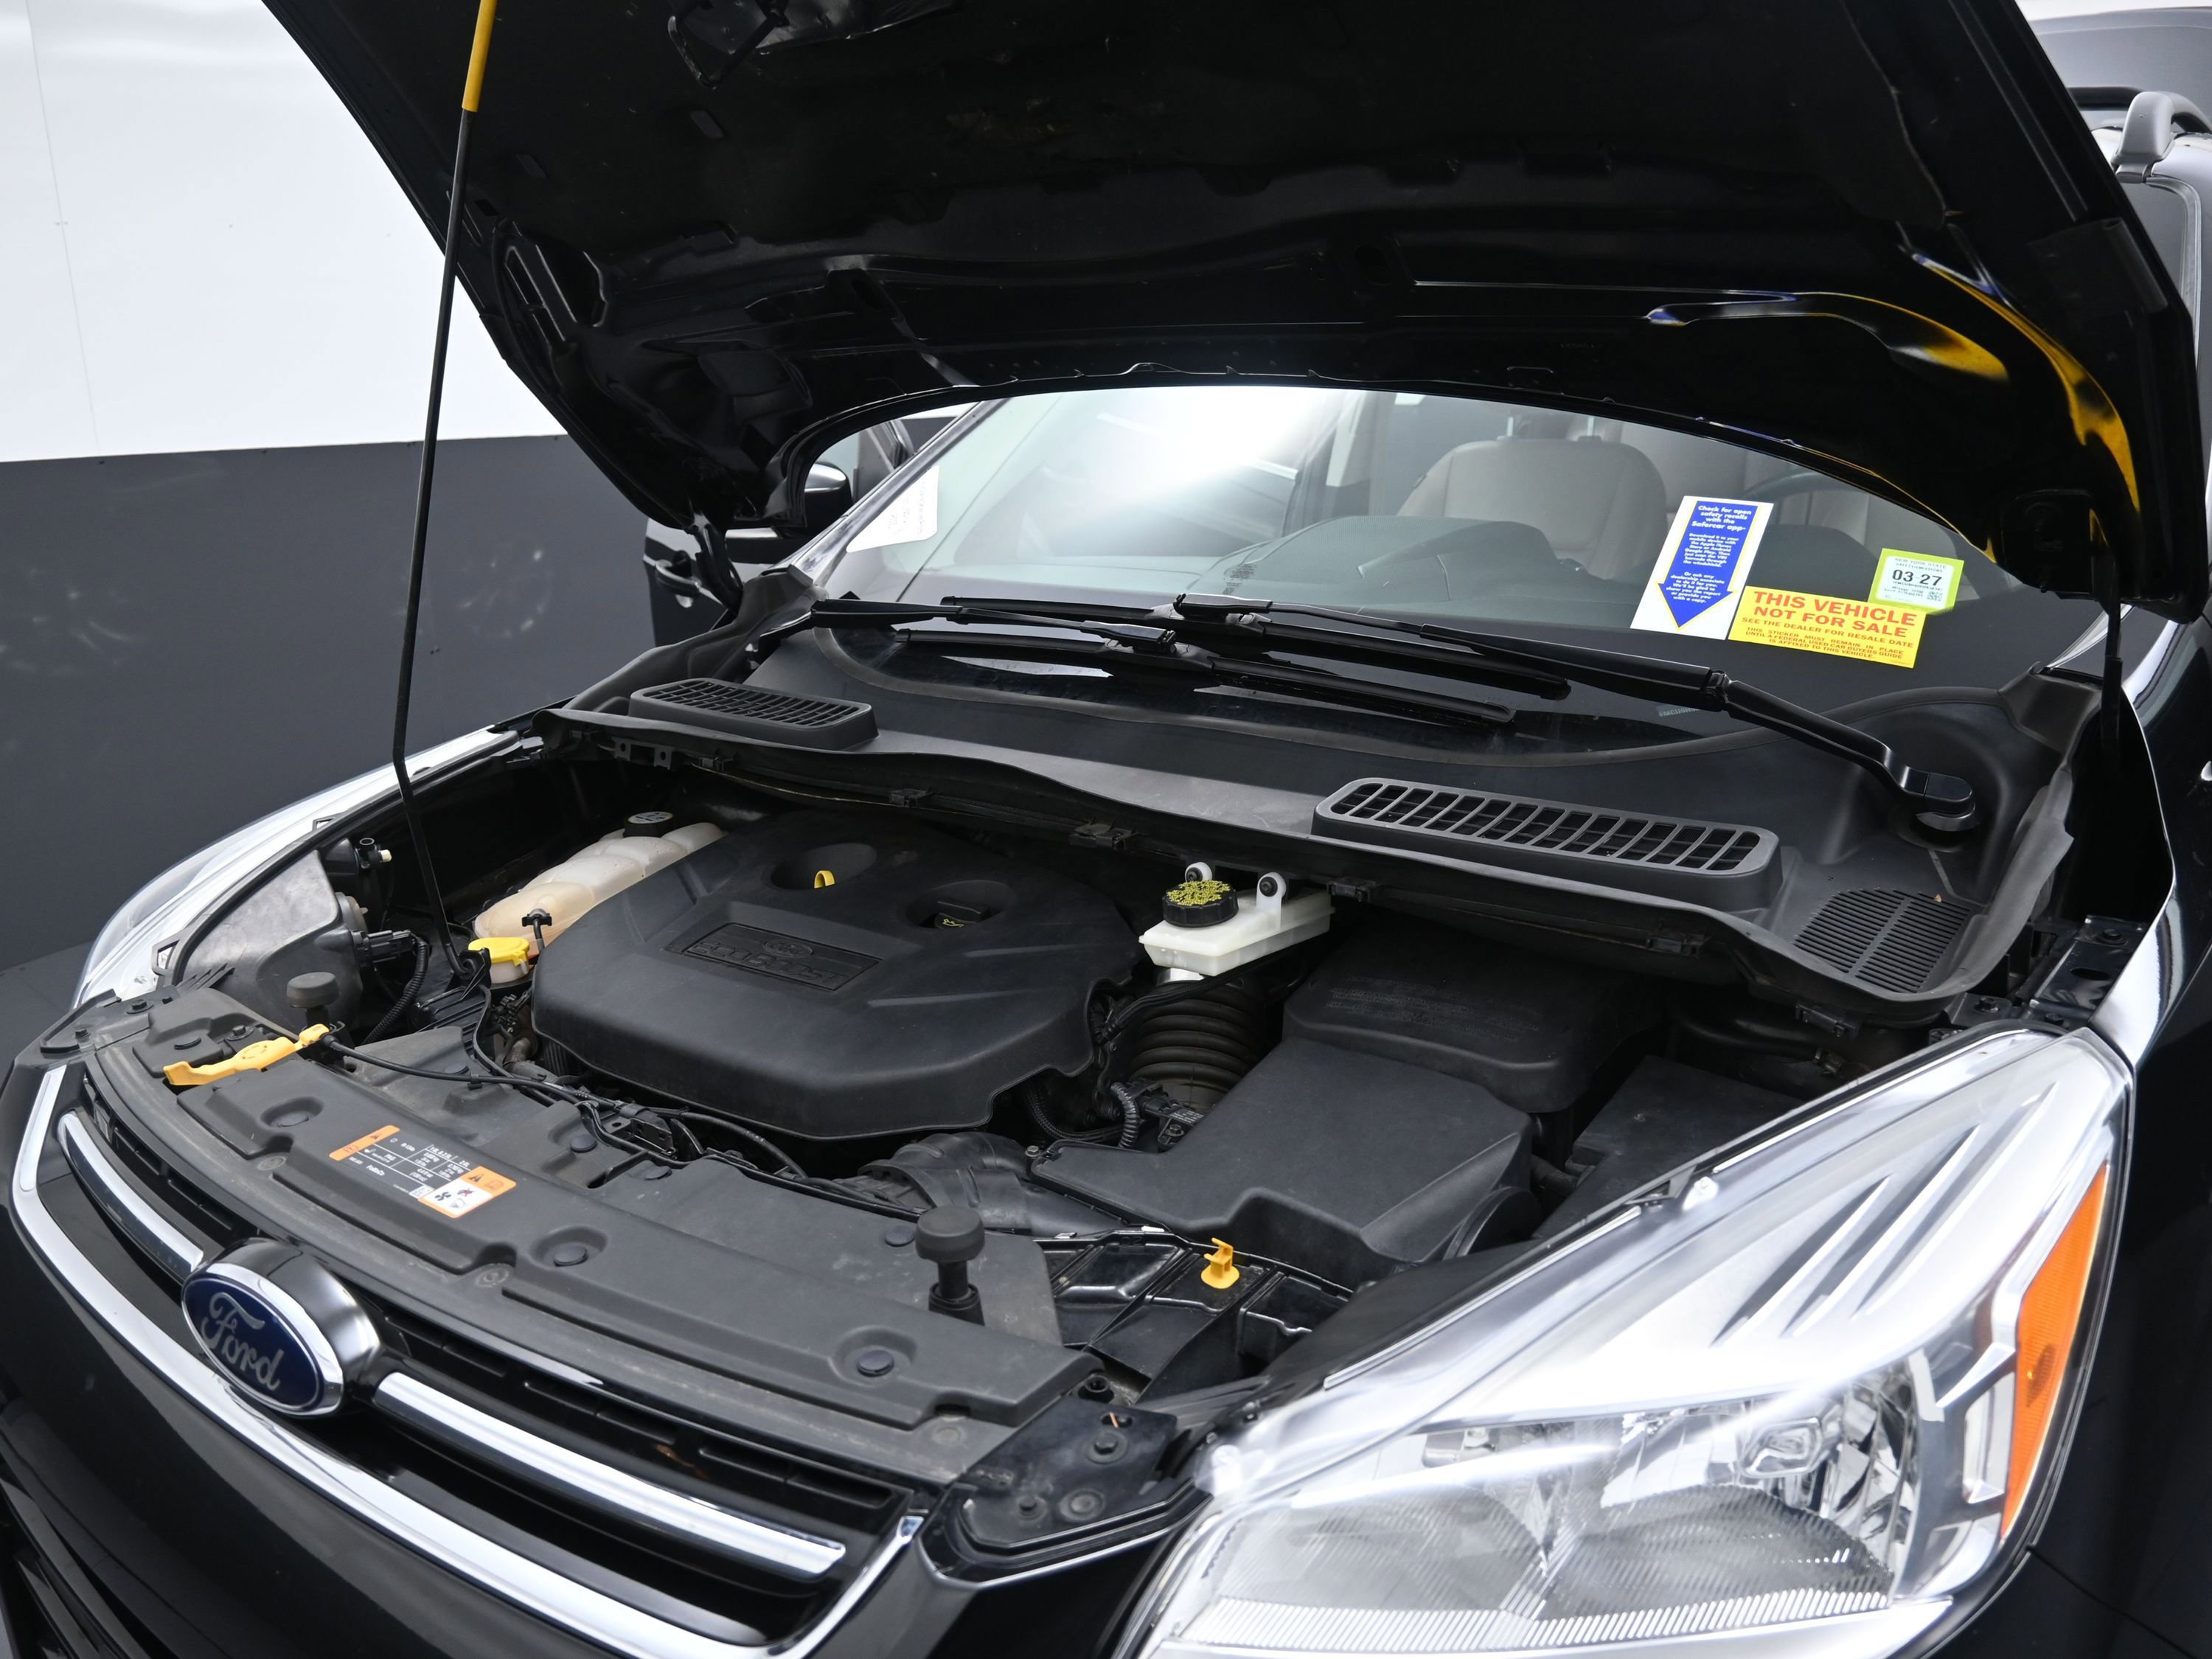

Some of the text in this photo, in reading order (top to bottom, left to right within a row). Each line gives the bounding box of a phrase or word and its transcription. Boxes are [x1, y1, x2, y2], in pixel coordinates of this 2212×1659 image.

[1892, 569, 1914, 582] 03
[1919, 574, 1942, 586] 27
[1754, 591, 1917, 626] THIS VEHICLE
[1754, 606, 1908, 637] NOT FOR SALE
[1768, 630, 1799, 638] STICKER
[1830, 639, 1861, 647] REMAIN
[1774, 634, 1808, 644] FEDERAL
[1809, 639, 1829, 647] USED
[1848, 646, 1877, 655] BUYERS
[1879, 650, 1904, 659] GUIDE
[1778, 640, 1809, 648] AFFIXED
[1784, 622, 1821, 633] DEALER
[1848, 633, 1886, 643] RESALE
[1889, 639, 1914, 648] DATE
[201, 1291, 285, 1391] Ford
